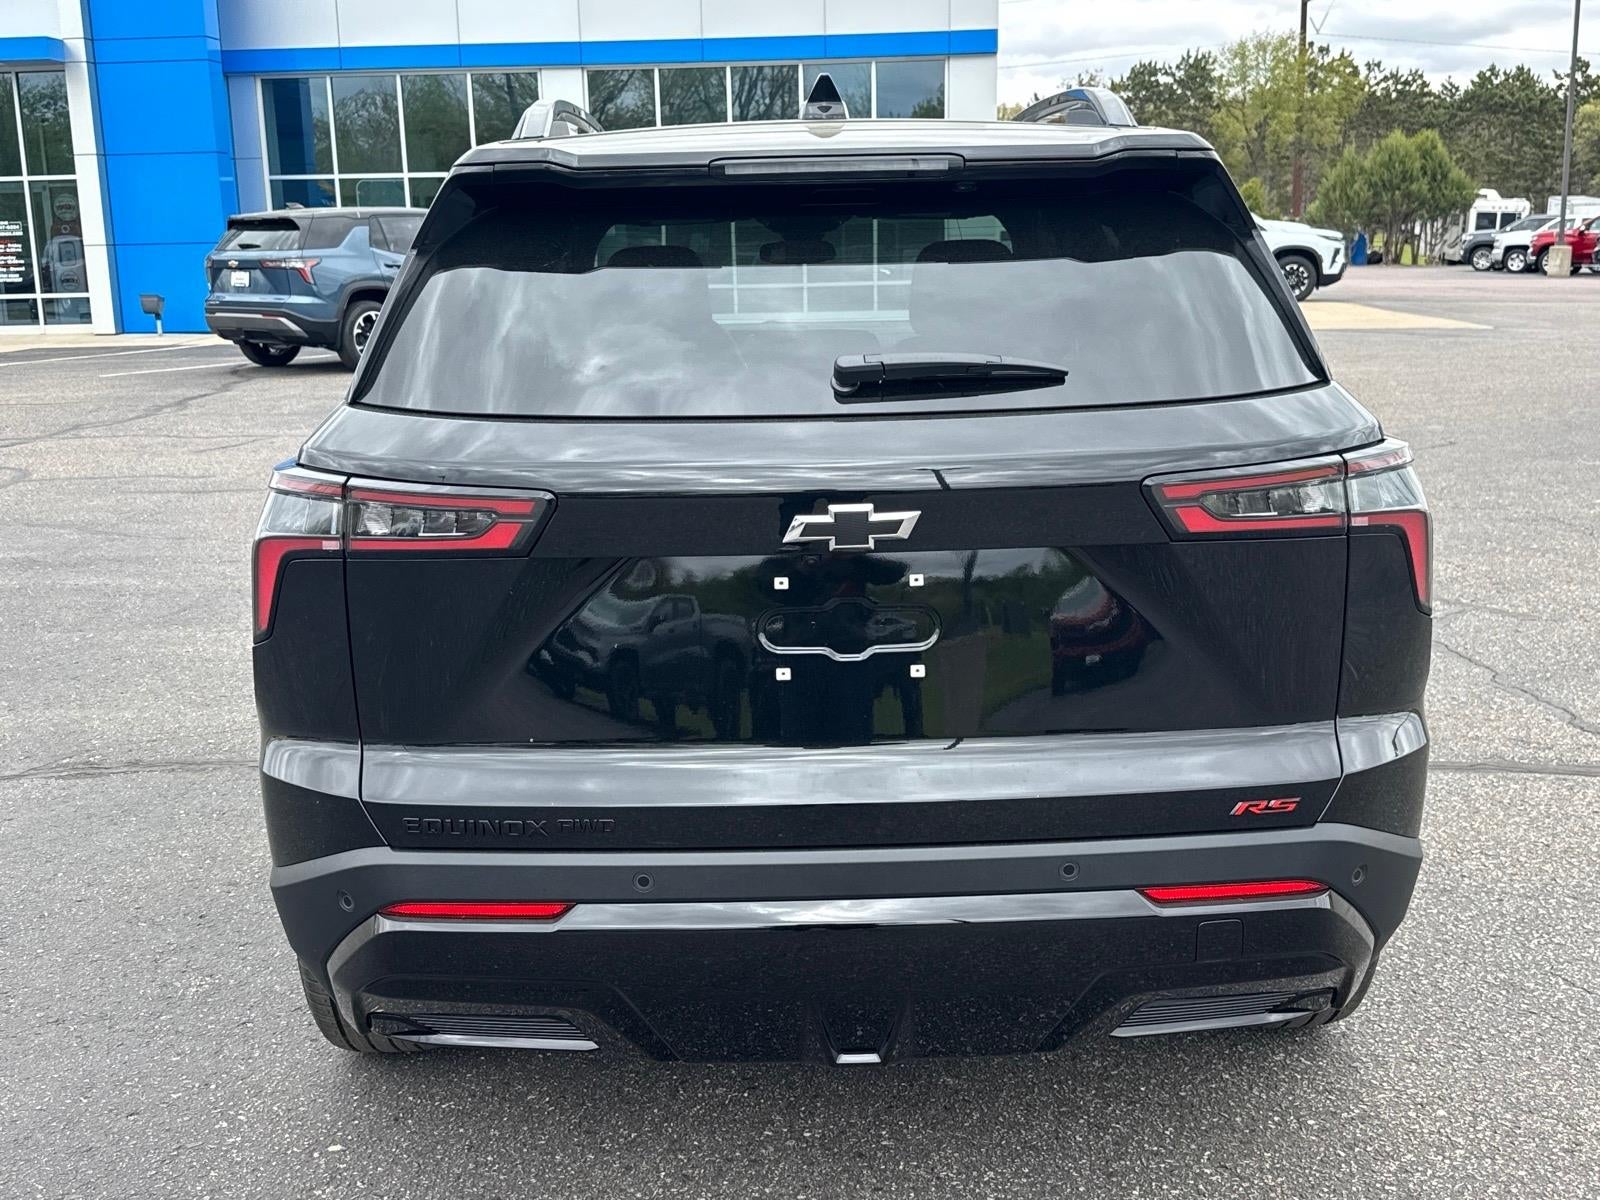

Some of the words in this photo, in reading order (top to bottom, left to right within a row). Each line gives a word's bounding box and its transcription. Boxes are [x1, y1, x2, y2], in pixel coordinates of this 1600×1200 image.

[1229, 797, 1301, 816] RS
[402, 816, 549, 837] EQUINOX
[556, 818, 616, 834] AWD
